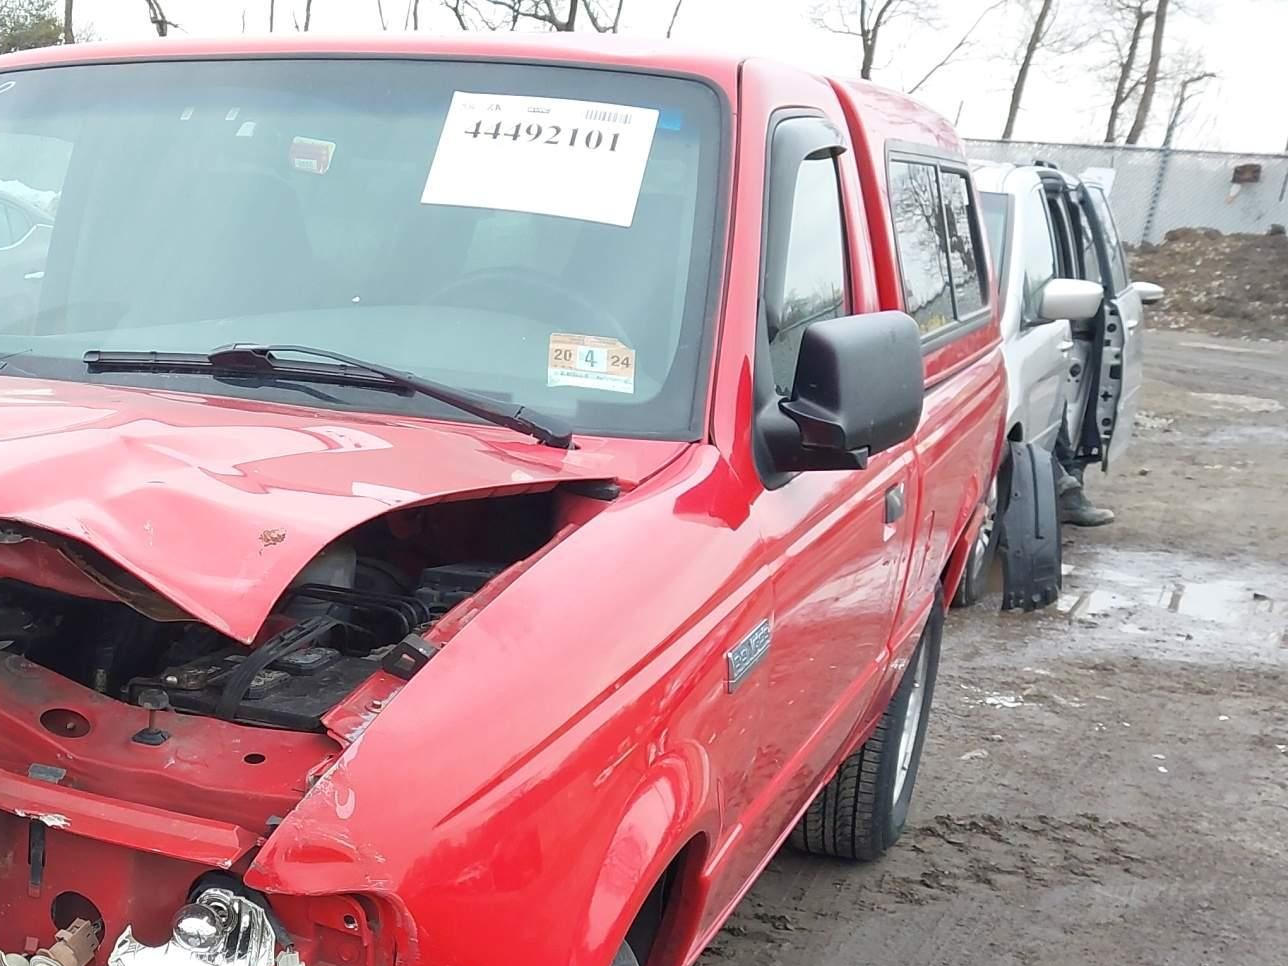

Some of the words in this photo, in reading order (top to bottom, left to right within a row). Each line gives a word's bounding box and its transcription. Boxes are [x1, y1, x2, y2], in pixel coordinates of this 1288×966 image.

[464, 120, 620, 152] 44492101
[554, 348, 572, 362] 20
[585, 349, 598, 368] 4
[610, 355, 632, 368] 24
